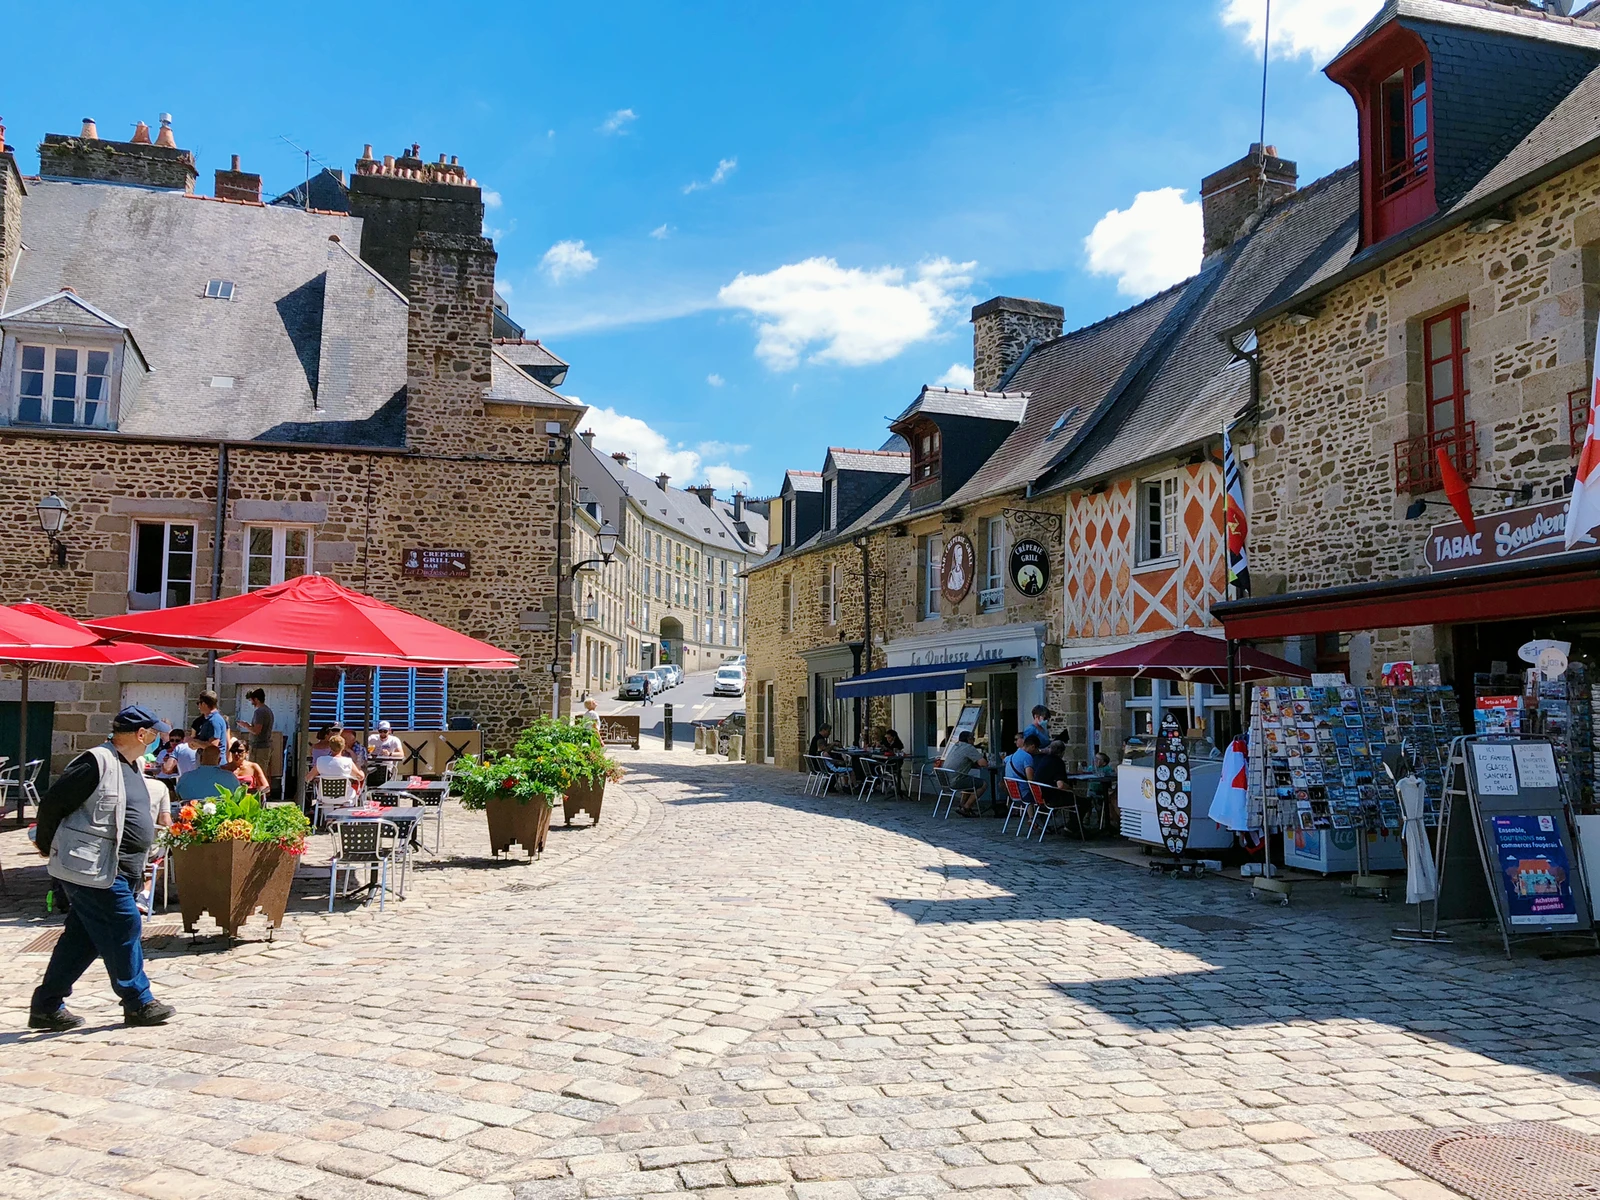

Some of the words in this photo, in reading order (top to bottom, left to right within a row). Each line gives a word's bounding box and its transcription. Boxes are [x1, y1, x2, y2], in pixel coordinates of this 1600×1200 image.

[1434, 532, 1483, 562] TABAC
[1494, 503, 1570, 557] Souveni
[1014, 542, 1043, 556] CRÊPERIE
[1020, 554, 1039, 562] GRILL
[416, 568, 448, 576] Duchesse
[910, 652, 921, 667] La
[925, 648, 969, 664] Duchesse
[974, 643, 1004, 661] Anne
[1486, 763, 1508, 772] GLACES
